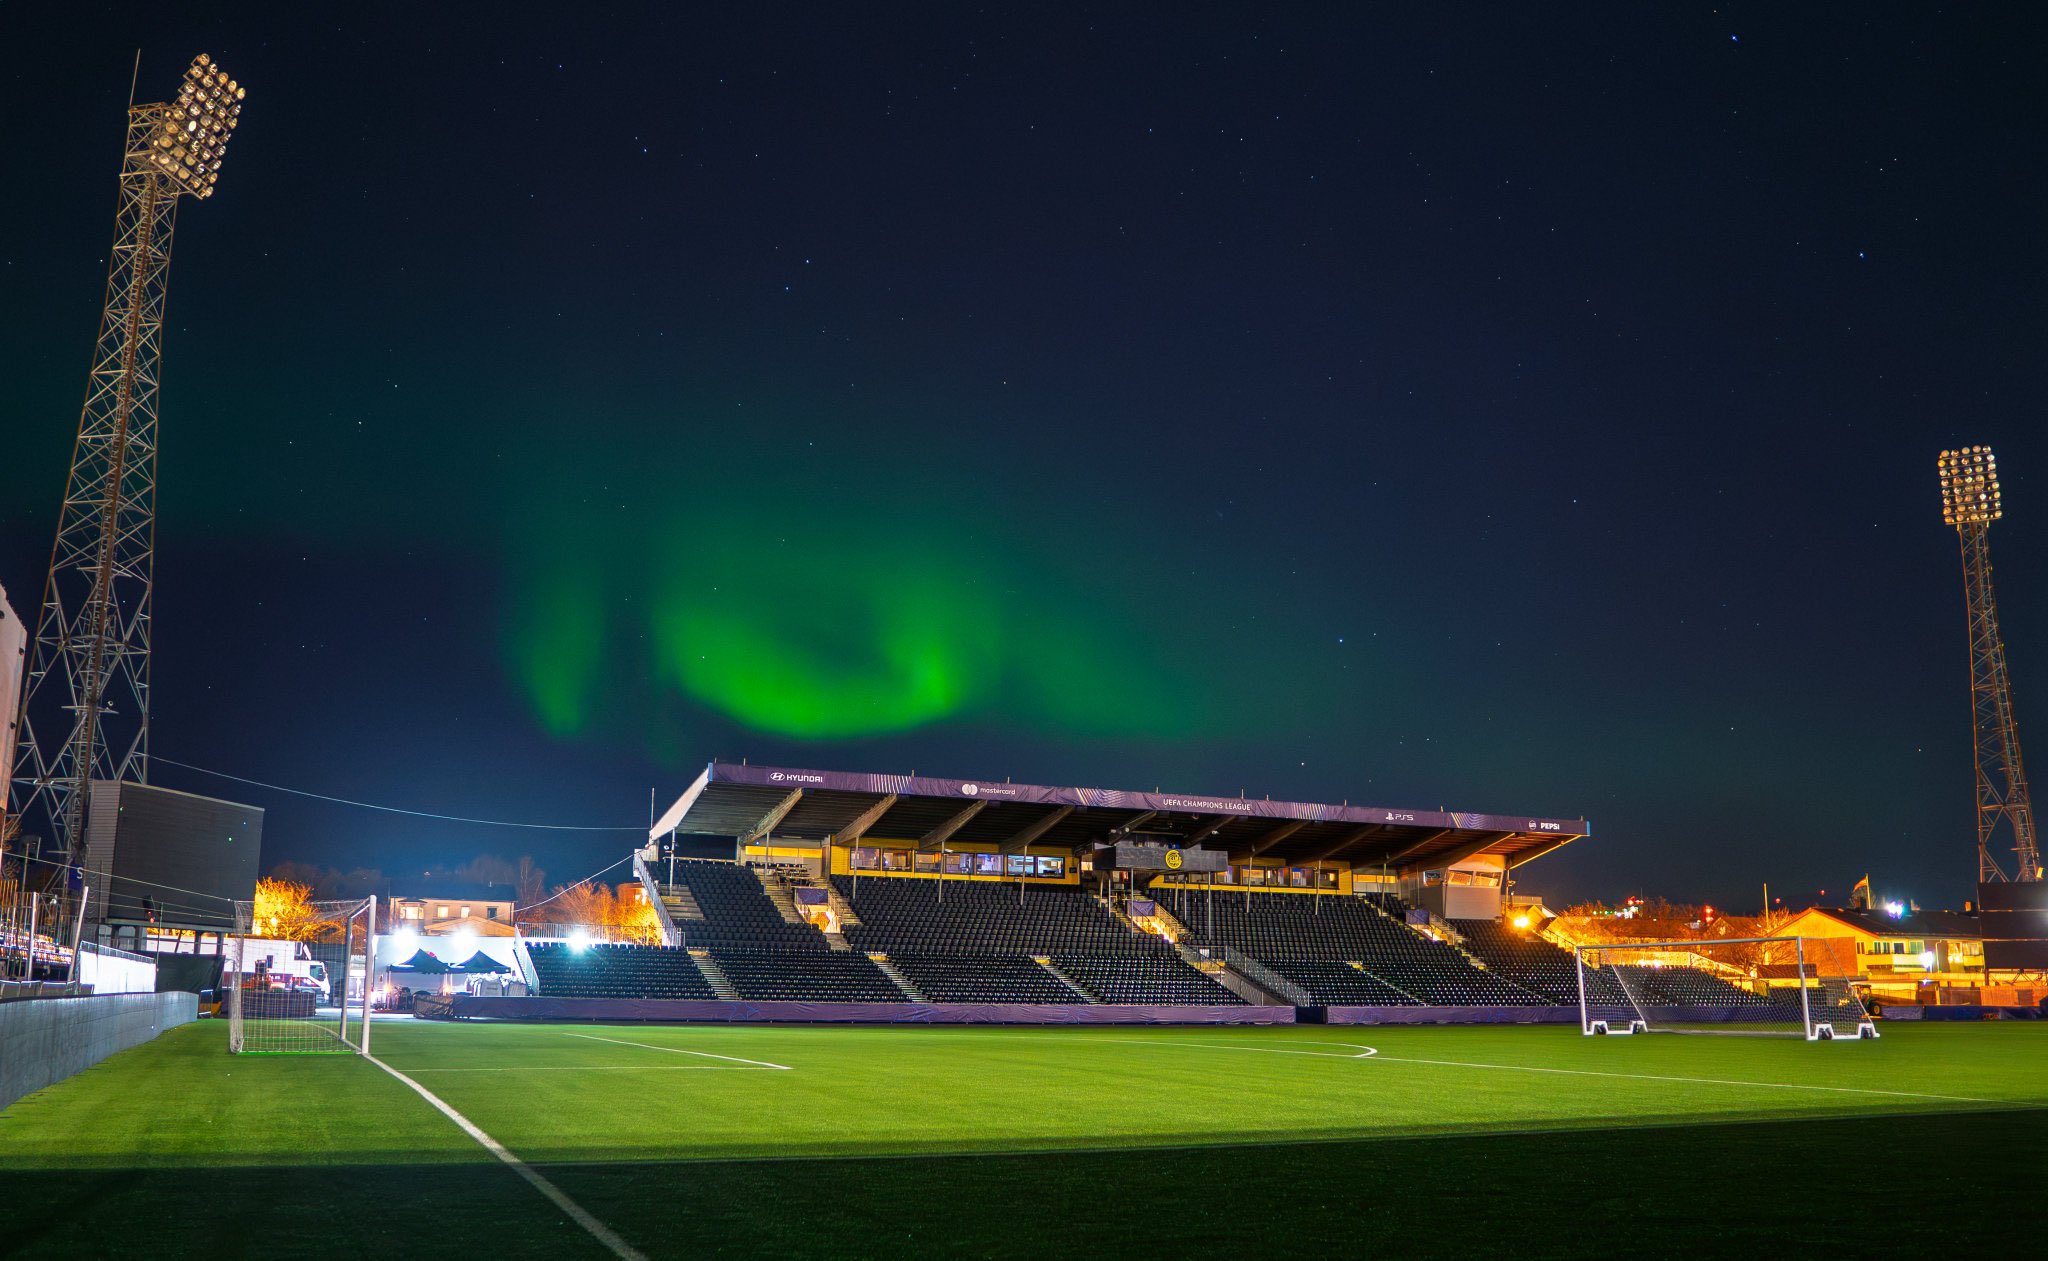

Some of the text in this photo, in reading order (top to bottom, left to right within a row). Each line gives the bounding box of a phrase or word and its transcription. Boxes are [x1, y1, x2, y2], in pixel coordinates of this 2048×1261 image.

[786, 774, 823, 783] HYUNDAI
[980, 787, 1016, 795] mastercard
[1182, 800, 1223, 810] CHAMPIONS
[1225, 803, 1251, 811] LEAGUE
[1395, 813, 1414, 821] PS5
[1540, 822, 1560, 830] PEPSI
